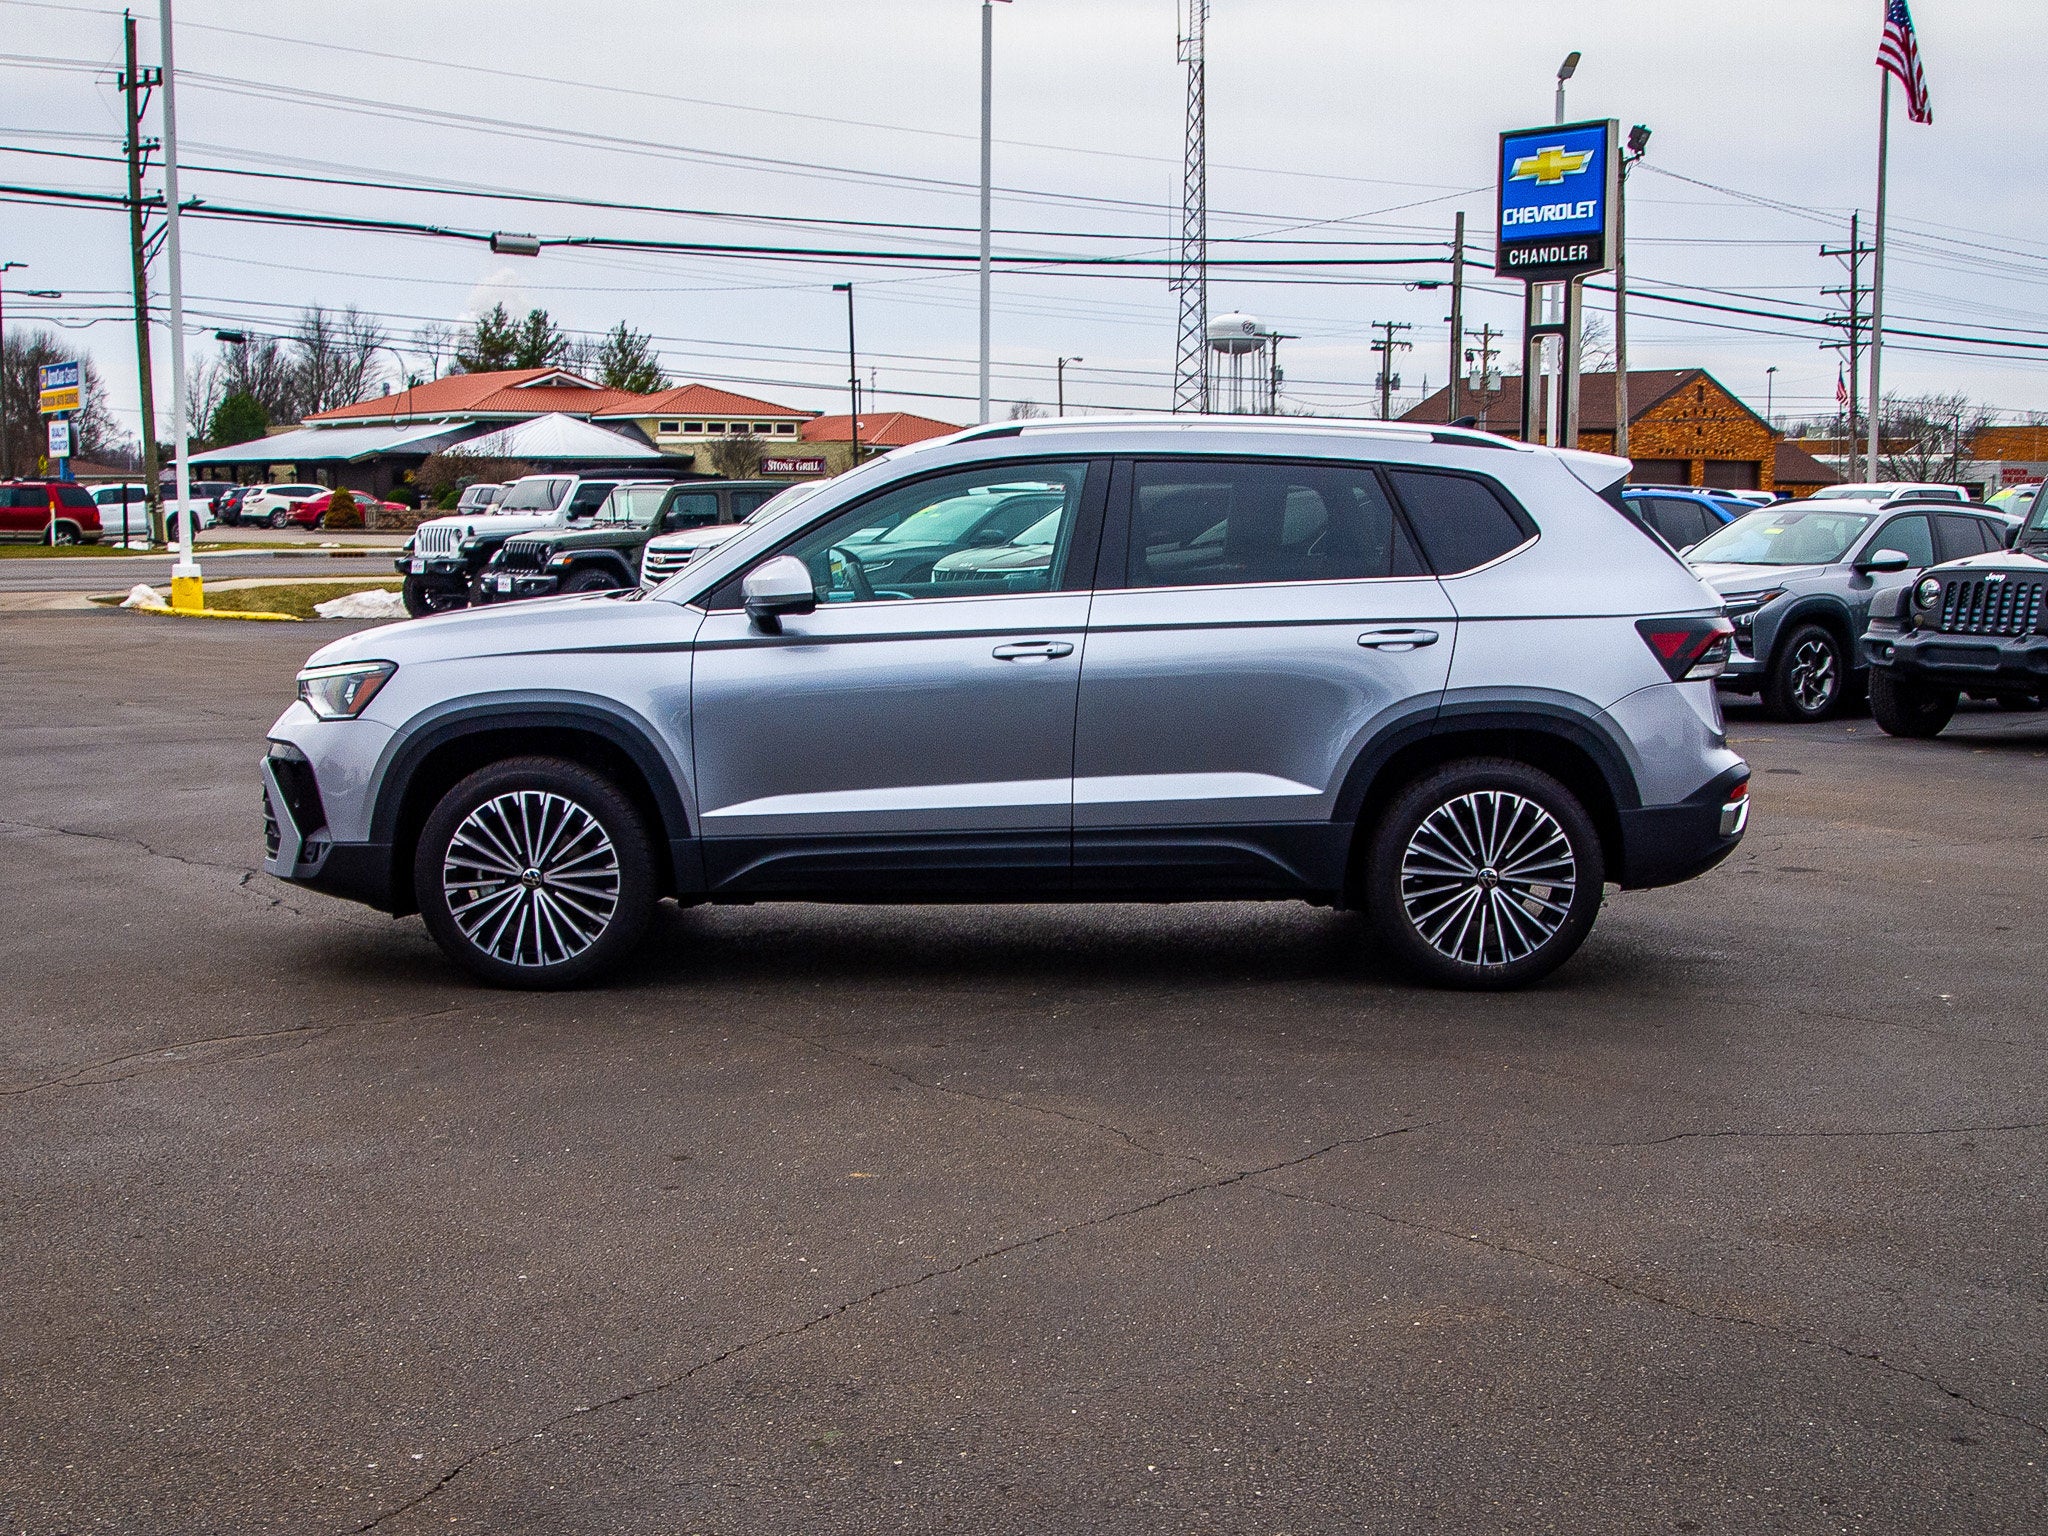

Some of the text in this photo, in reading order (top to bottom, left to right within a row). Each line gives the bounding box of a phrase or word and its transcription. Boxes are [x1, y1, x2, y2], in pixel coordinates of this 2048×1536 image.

[1503, 200, 1597, 225] CHEVROLET
[1509, 244, 1588, 265] CHANDLER
[767, 460, 819, 471] STONE GRILL
[1985, 572, 2006, 582] Jeep
